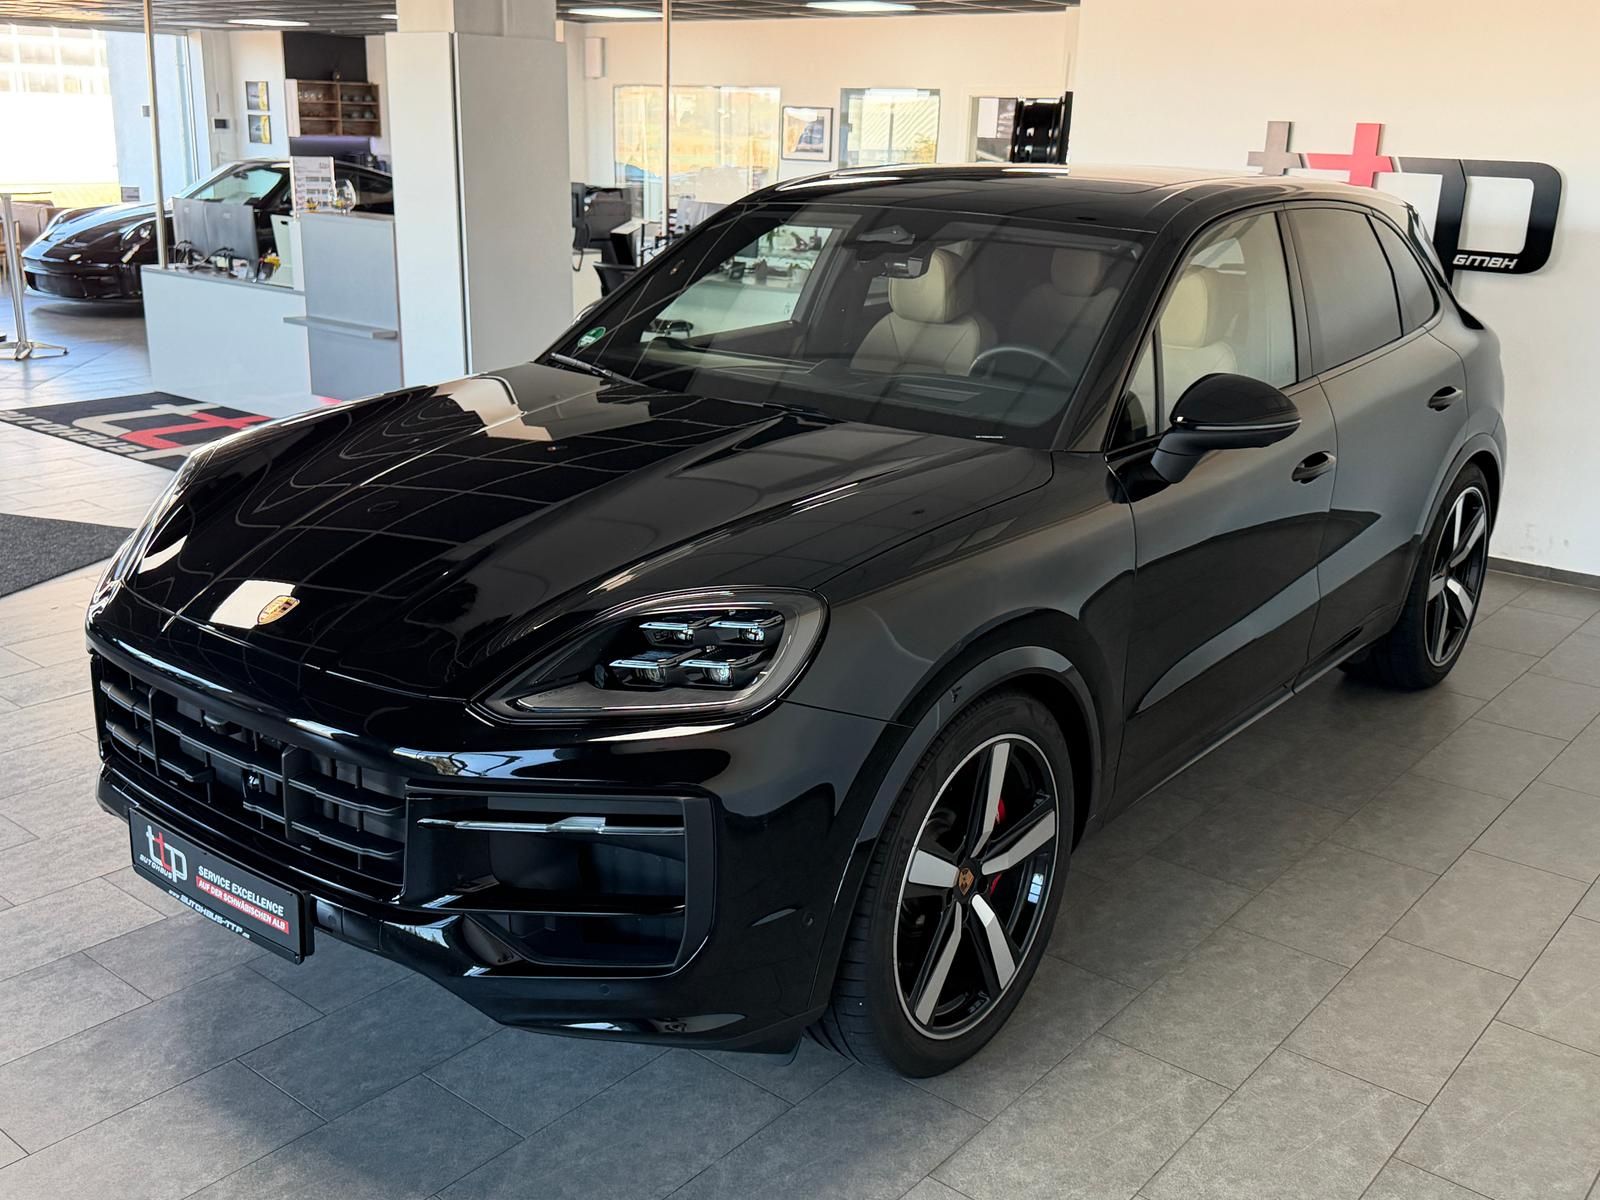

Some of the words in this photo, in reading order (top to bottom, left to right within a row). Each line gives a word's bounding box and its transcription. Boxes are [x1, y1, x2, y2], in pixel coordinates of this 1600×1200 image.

[72, 403, 273, 463] tt
[145, 825, 187, 883] ttp
[198, 865, 230, 891] SERVICE
[231, 883, 284, 917] EXCELLENCE
[198, 880, 210, 892] AUF
[210, 886, 223, 899] DER
[223, 892, 271, 922] SCHWÄBISCHEN
[272, 916, 285, 930] ALB
